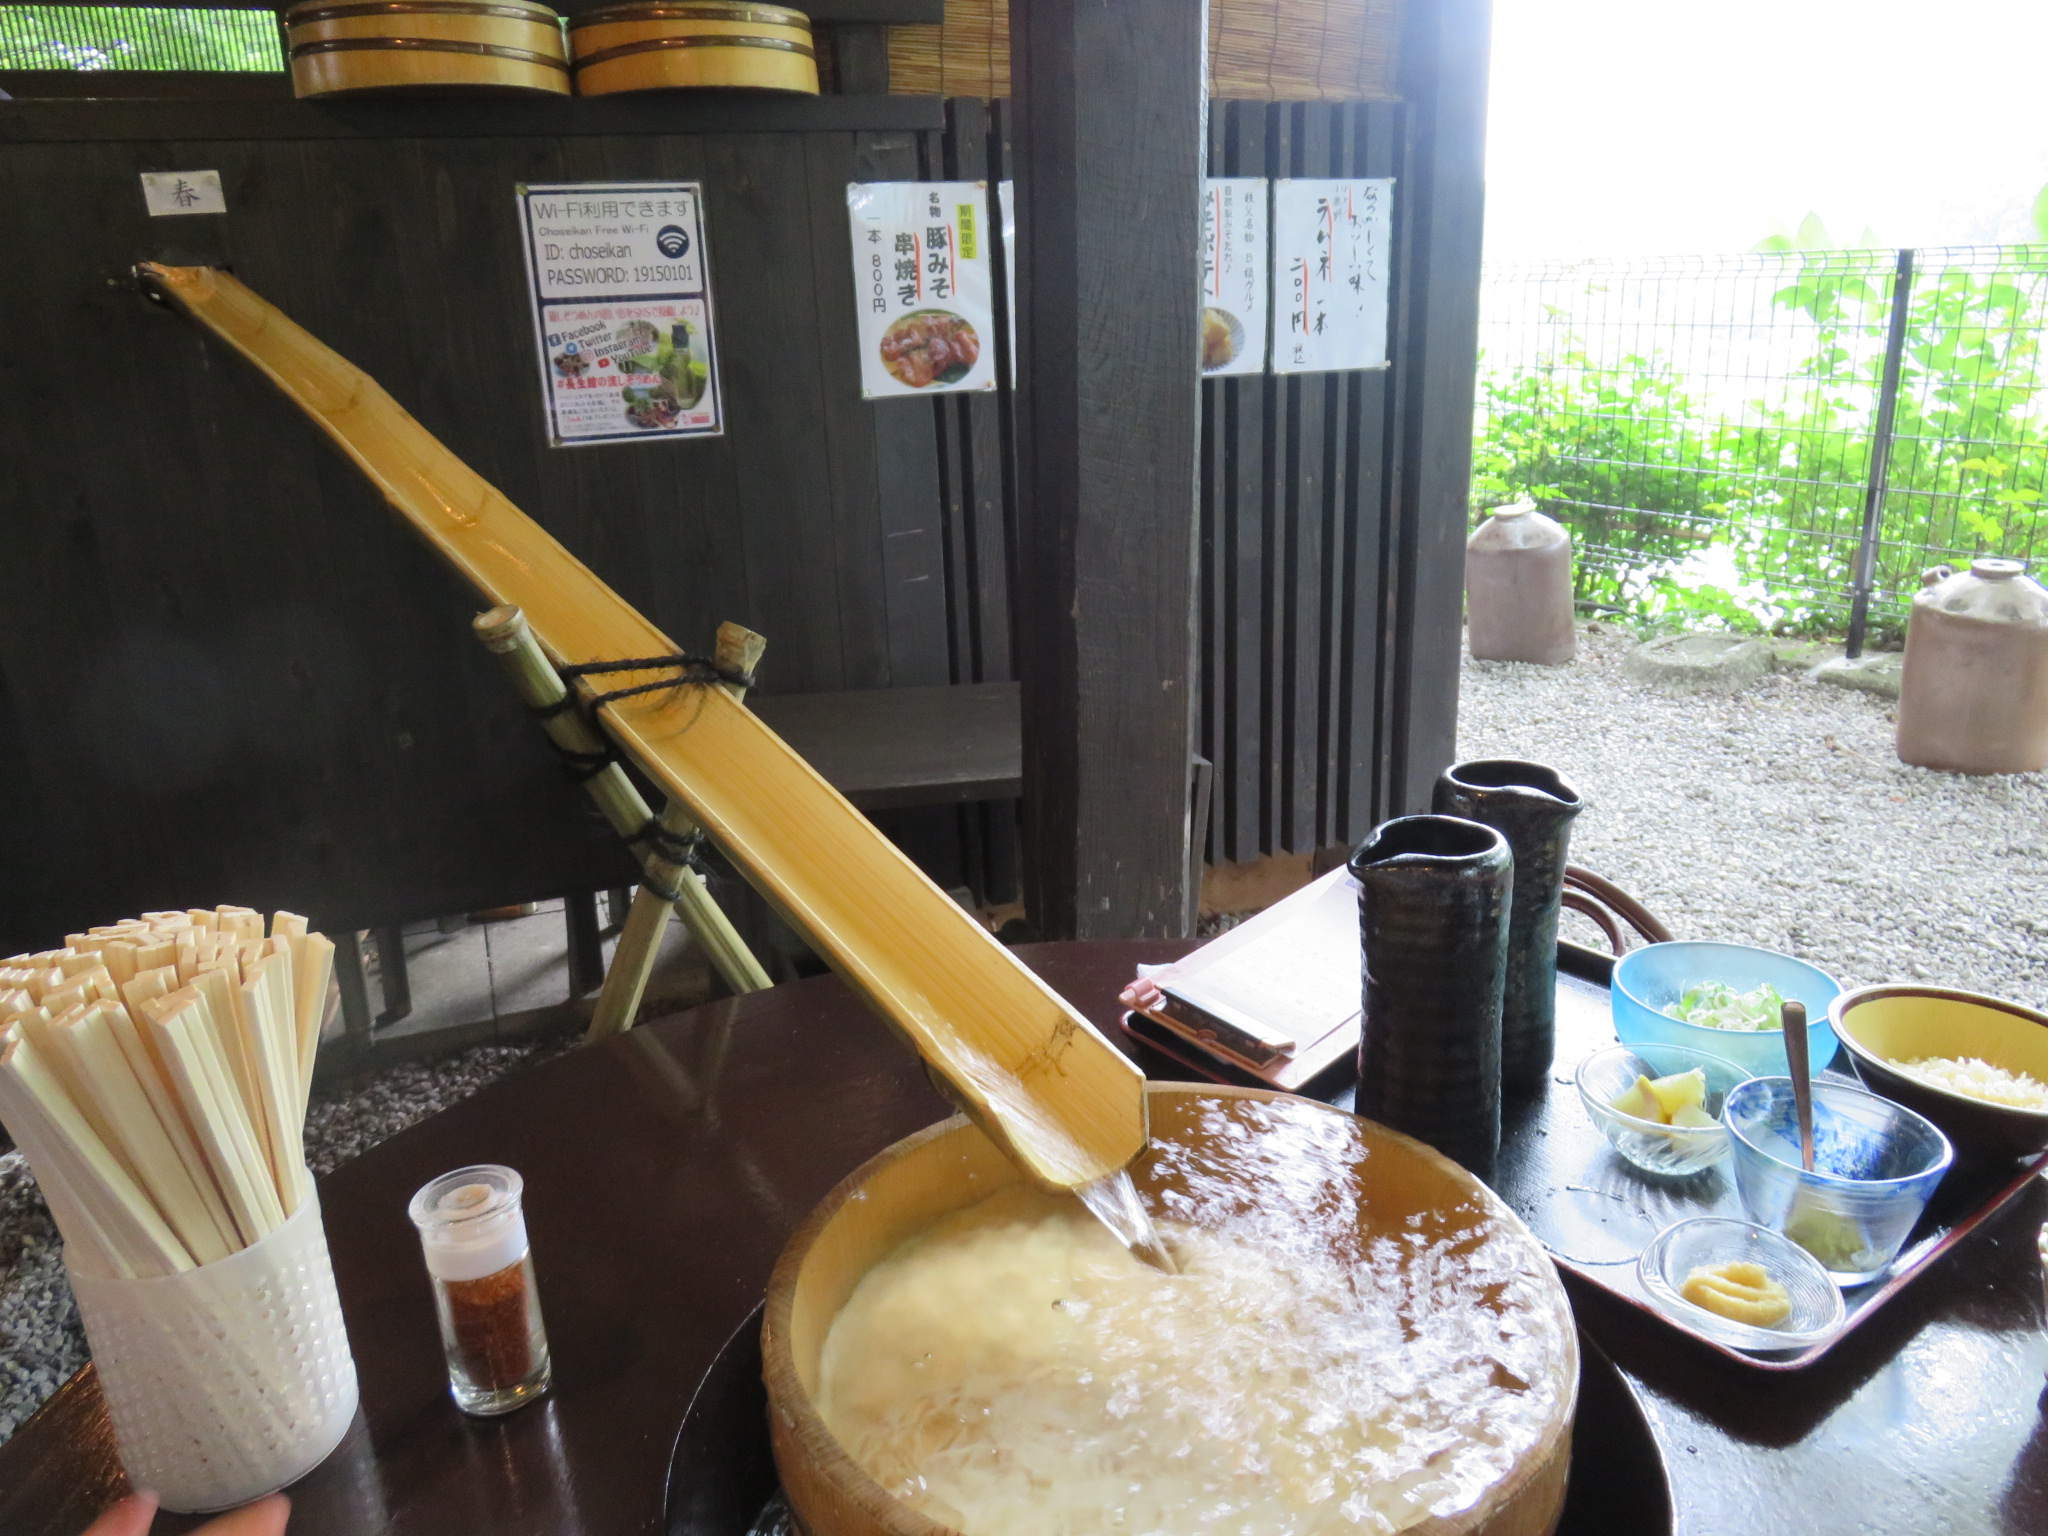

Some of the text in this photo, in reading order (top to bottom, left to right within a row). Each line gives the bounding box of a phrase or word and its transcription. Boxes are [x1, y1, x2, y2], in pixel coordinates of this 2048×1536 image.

[171, 178, 201, 208] 春
[534, 199, 690, 220] Wi-Fi利用できます
[538, 224, 649, 237] Choseikan Free Wi-Fi
[960, 205, 973, 258] 期間限定
[544, 242, 632, 261] ID: choseikan
[926, 192, 950, 300] 名物 豚みそ
[547, 264, 694, 286] PASSWORD: 19150101
[895, 232, 917, 307] 串焼き
[872, 254, 886, 313] 800円
[561, 320, 607, 342] Facebook
[578, 332, 613, 350] Twitter
[594, 335, 642, 358] Instagram
[610, 344, 653, 365] YouTube
